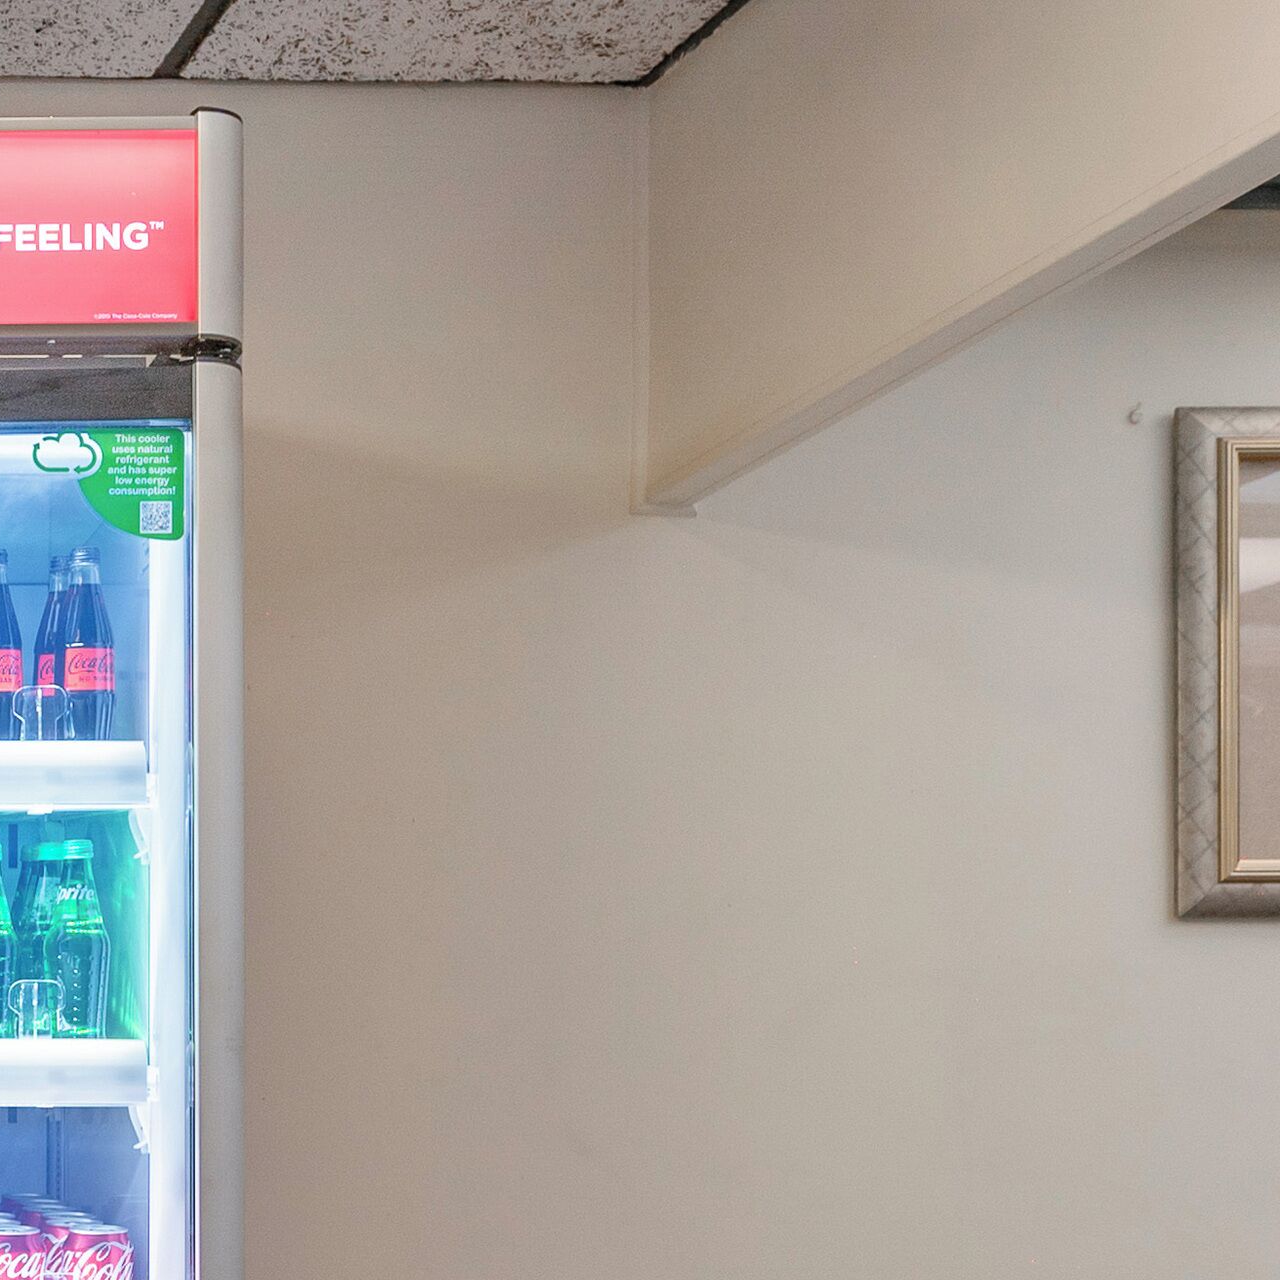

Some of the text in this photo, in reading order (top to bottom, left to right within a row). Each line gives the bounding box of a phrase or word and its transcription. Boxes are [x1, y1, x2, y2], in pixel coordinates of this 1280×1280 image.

[115, 433, 170, 443] This cooler
[112, 444, 173, 454] uses natural
[115, 455, 170, 466] refrigerant
[107, 466, 177, 476] and has super
[115, 476, 170, 487] low energy
[108, 486, 176, 497] consumption!
